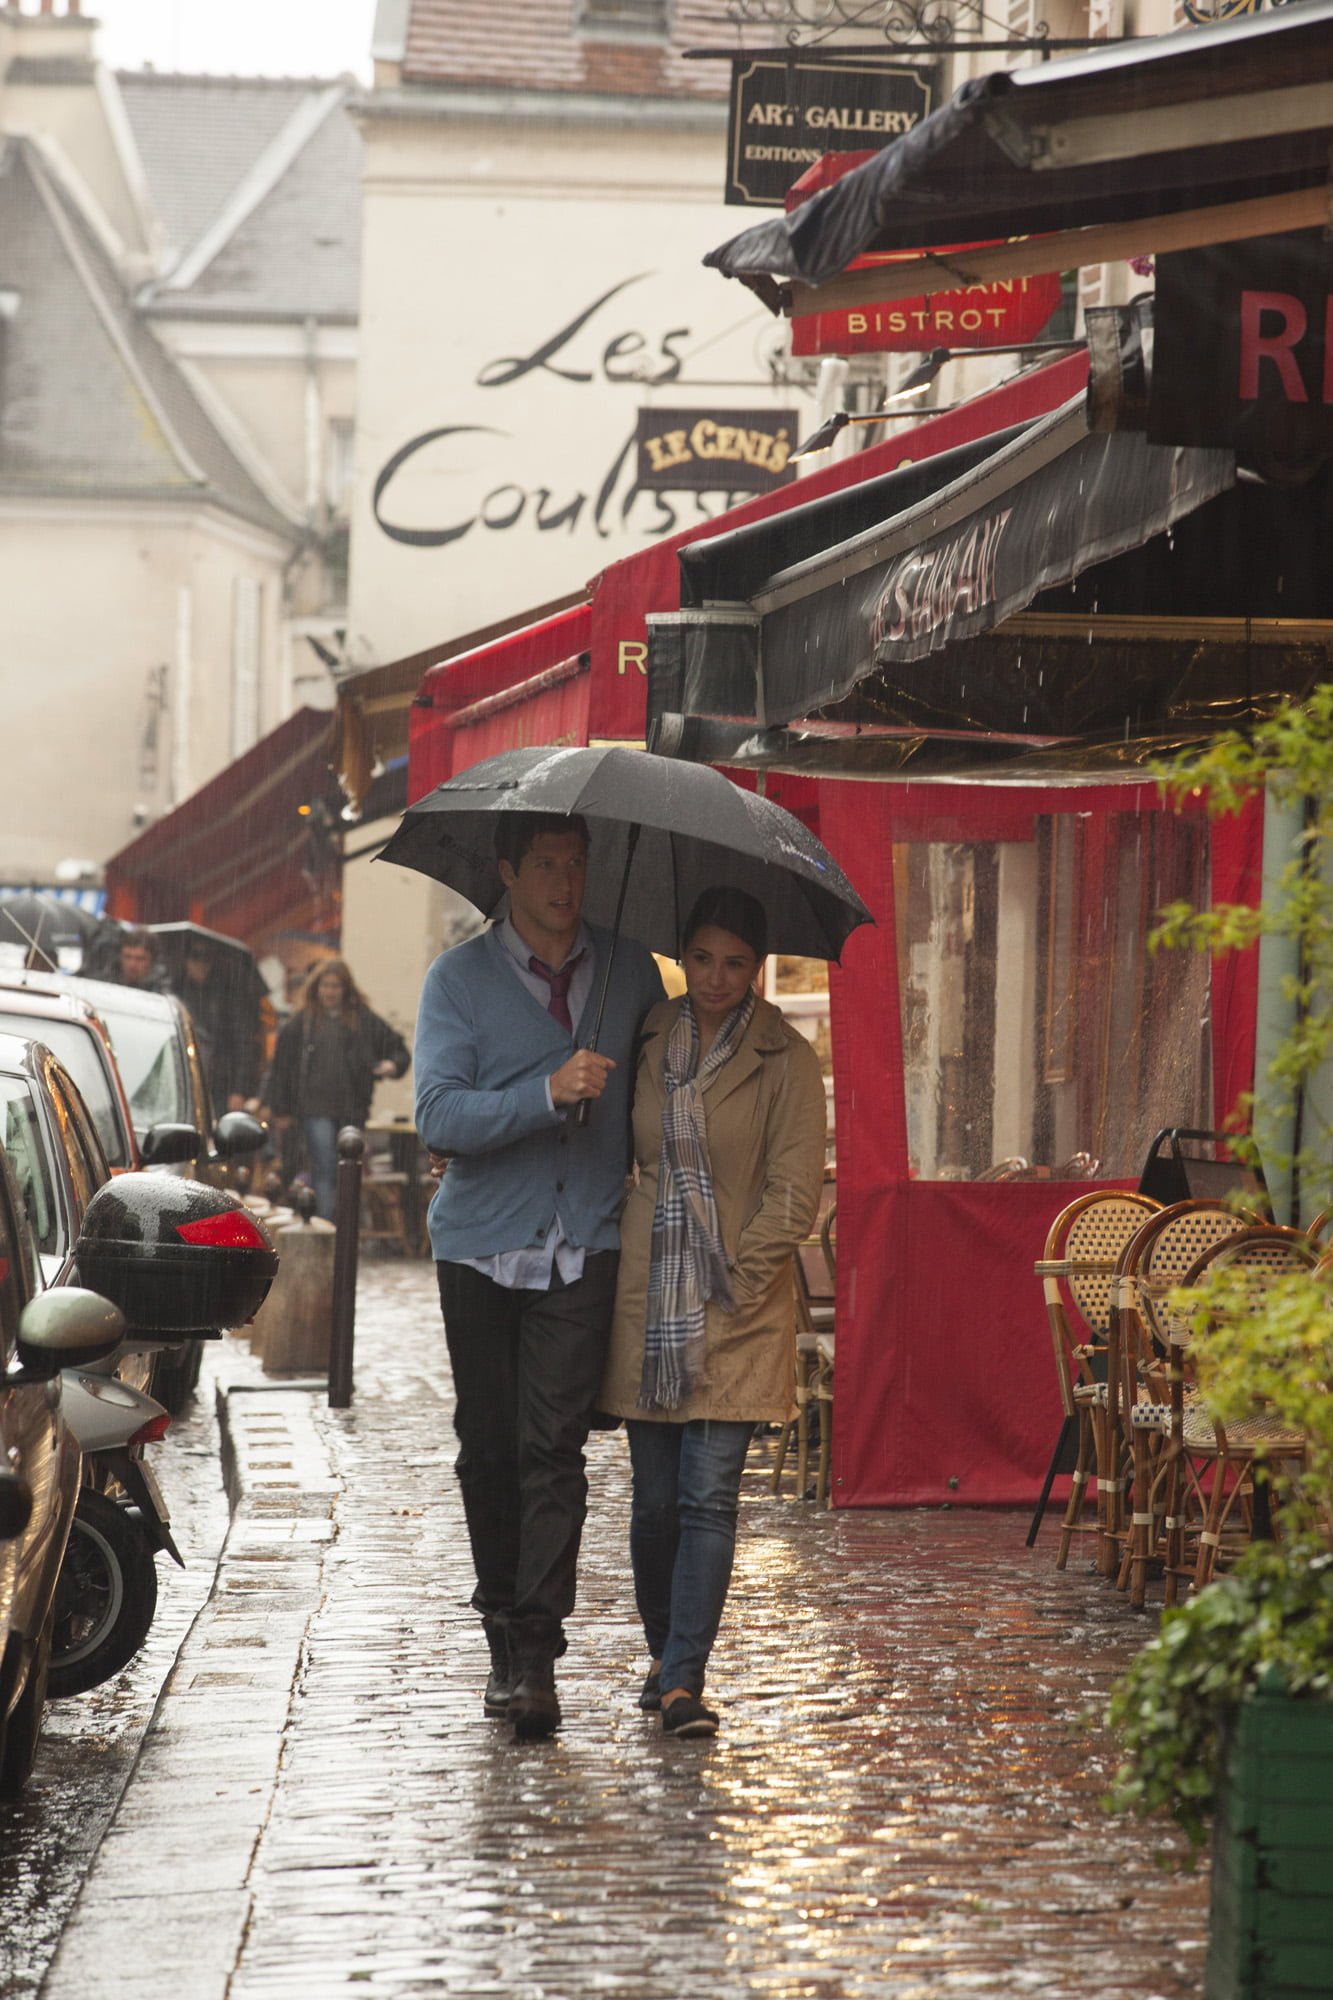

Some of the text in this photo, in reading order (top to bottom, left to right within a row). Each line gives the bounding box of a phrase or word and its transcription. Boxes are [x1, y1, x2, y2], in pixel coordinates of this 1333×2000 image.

[748, 102, 919, 133] ART GALLERY
[744, 144, 822, 163] EDITIONS
[476, 269, 690, 387] Les
[848, 308, 1007, 334] BISTROT
[645, 429, 693, 473] LE
